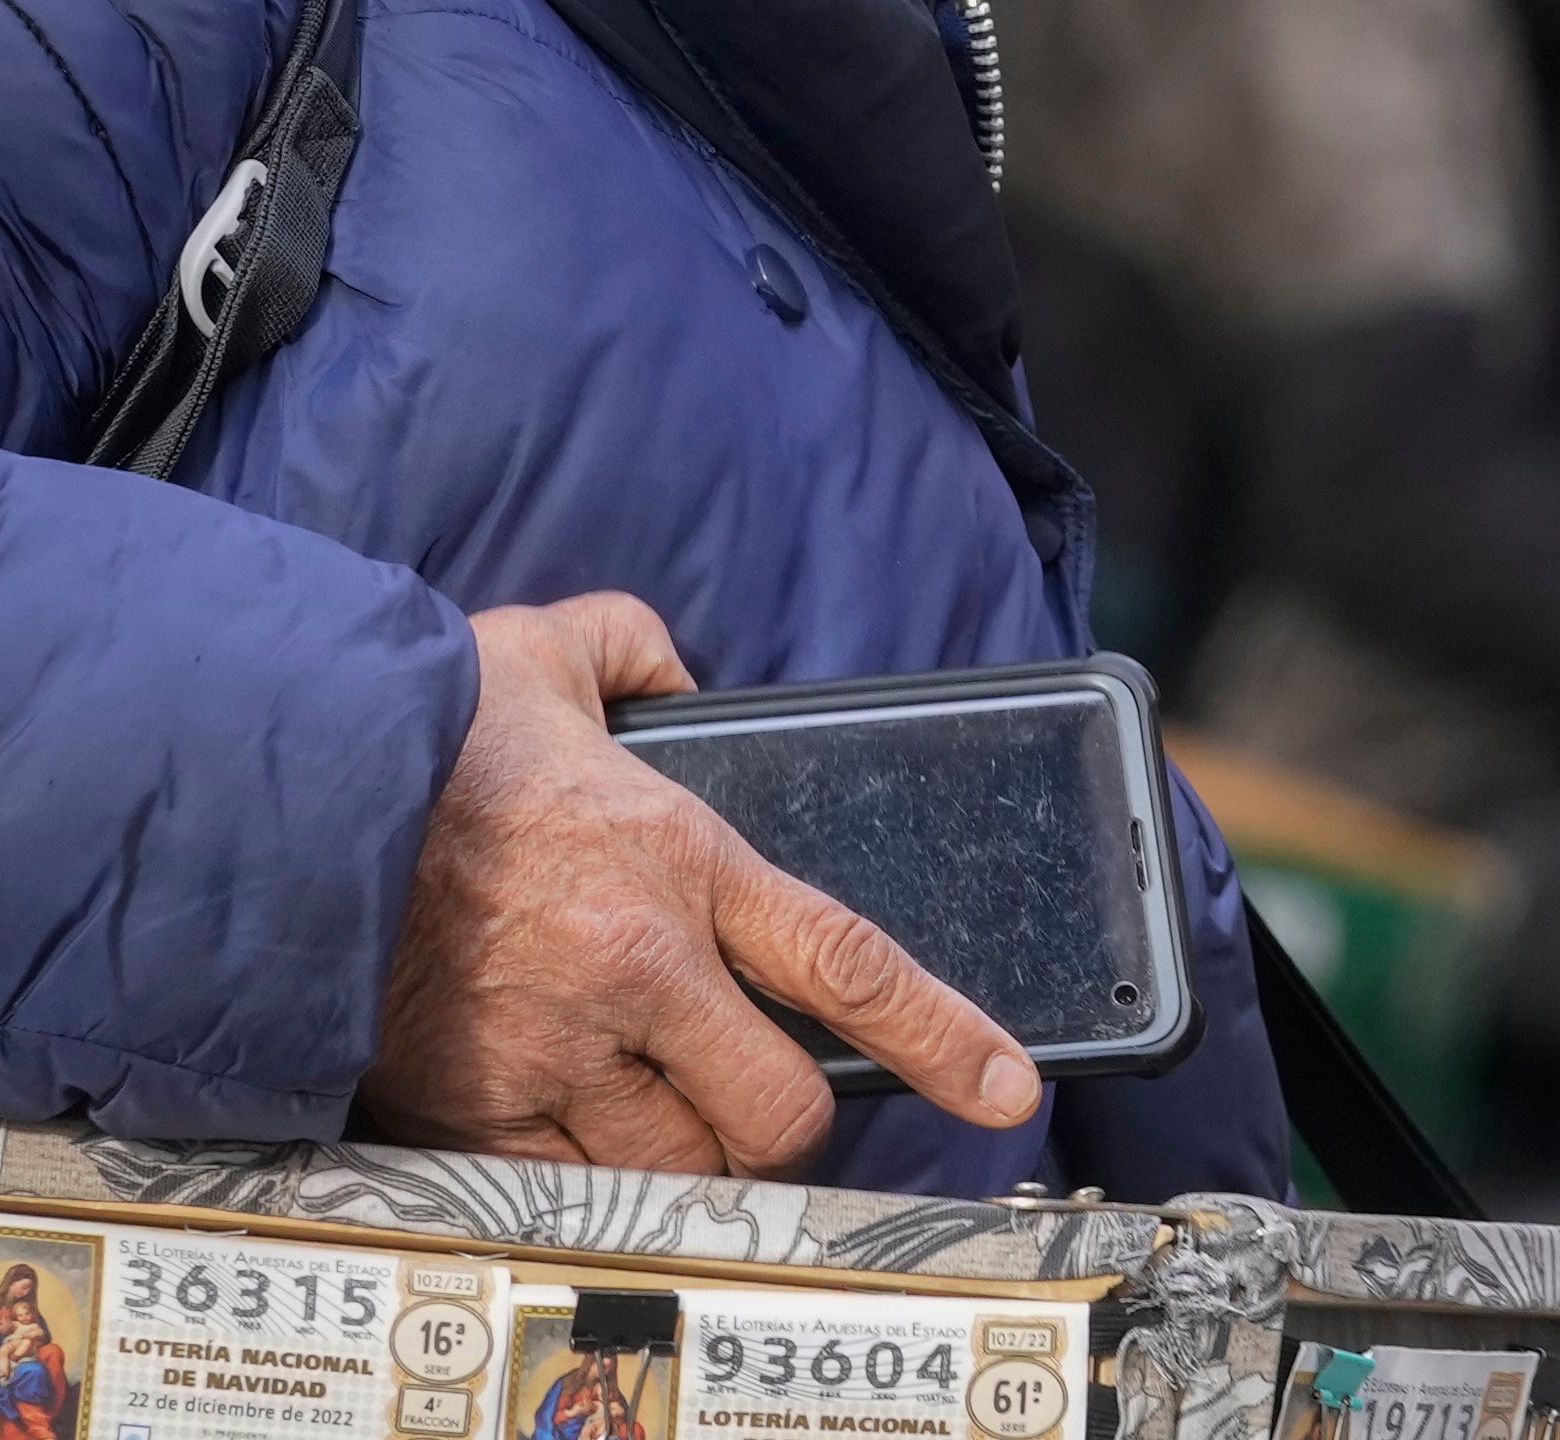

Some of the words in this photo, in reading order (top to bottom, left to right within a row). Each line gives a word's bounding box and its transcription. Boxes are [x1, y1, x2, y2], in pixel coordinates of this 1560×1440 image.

[123, 1260, 378, 1326] 36315
[119, 1338, 230, 1363] LOTERÍA
[241, 1347, 373, 1375] NACIONAL
[425, 1365, 451, 1375] SERIE
[703, 1335, 959, 1389] 93604
[163, 1369, 195, 1386] DE
[207, 1372, 326, 1398] NAVIDAD
[129, 1393, 149, 1408] 22
[156, 1394, 178, 1410] de
[185, 1397, 275, 1419] diciembre
[282, 1407, 303, 1422] de
[310, 1409, 353, 1426] 2022
[405, 1415, 459, 1428] FRACCIÓN
[699, 1410, 809, 1430] LOTERÍA
[820, 1416, 950, 1435] NACIONAL
